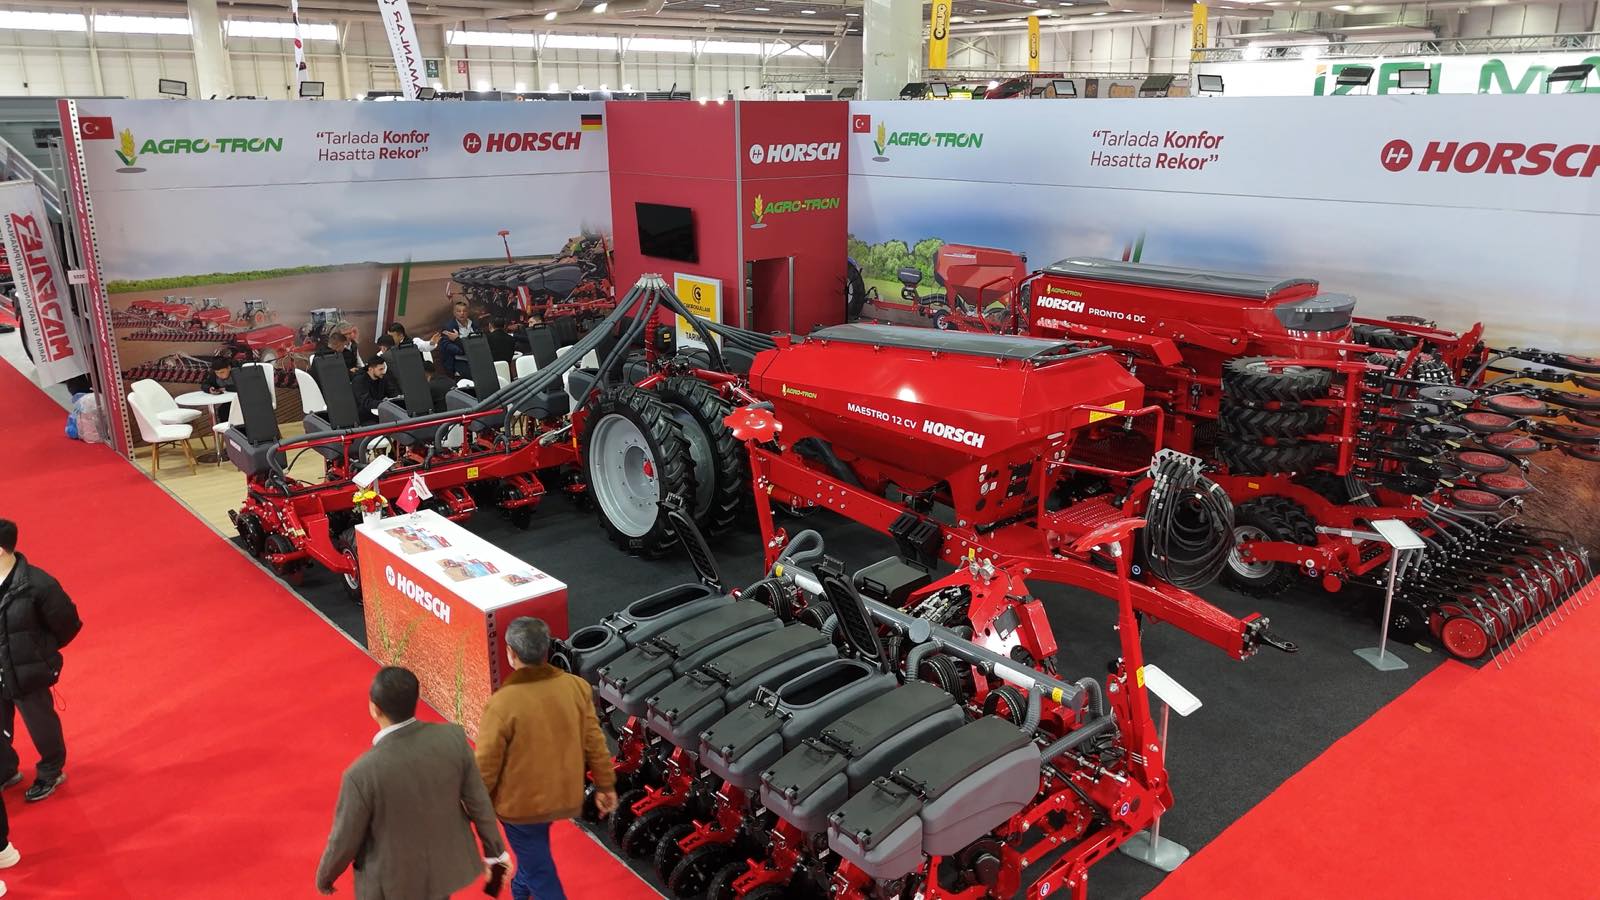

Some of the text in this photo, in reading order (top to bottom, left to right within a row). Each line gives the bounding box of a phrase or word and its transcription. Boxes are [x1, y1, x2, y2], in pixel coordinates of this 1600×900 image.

[139, 137, 283, 154] AGRO-TRON
[316, 130, 429, 144] “Tarlada Konfor
[486, 131, 582, 153] HORSCH
[886, 131, 984, 150] AGRO-TRON
[1092, 131, 1224, 149] “Tarlada Konfor
[319, 147, 429, 161] Hasatta Rekor”
[766, 143, 841, 163] HORSCH
[1090, 151, 1219, 170] Hasatta Rekor”
[764, 197, 840, 214] AGRO-TRON
[1037, 296, 1146, 323] HORSCH PRONTO 4 DC
[847, 402, 986, 449] MAESTRO 12 CV HORSCH
[397, 572, 450, 625] HORSCH
